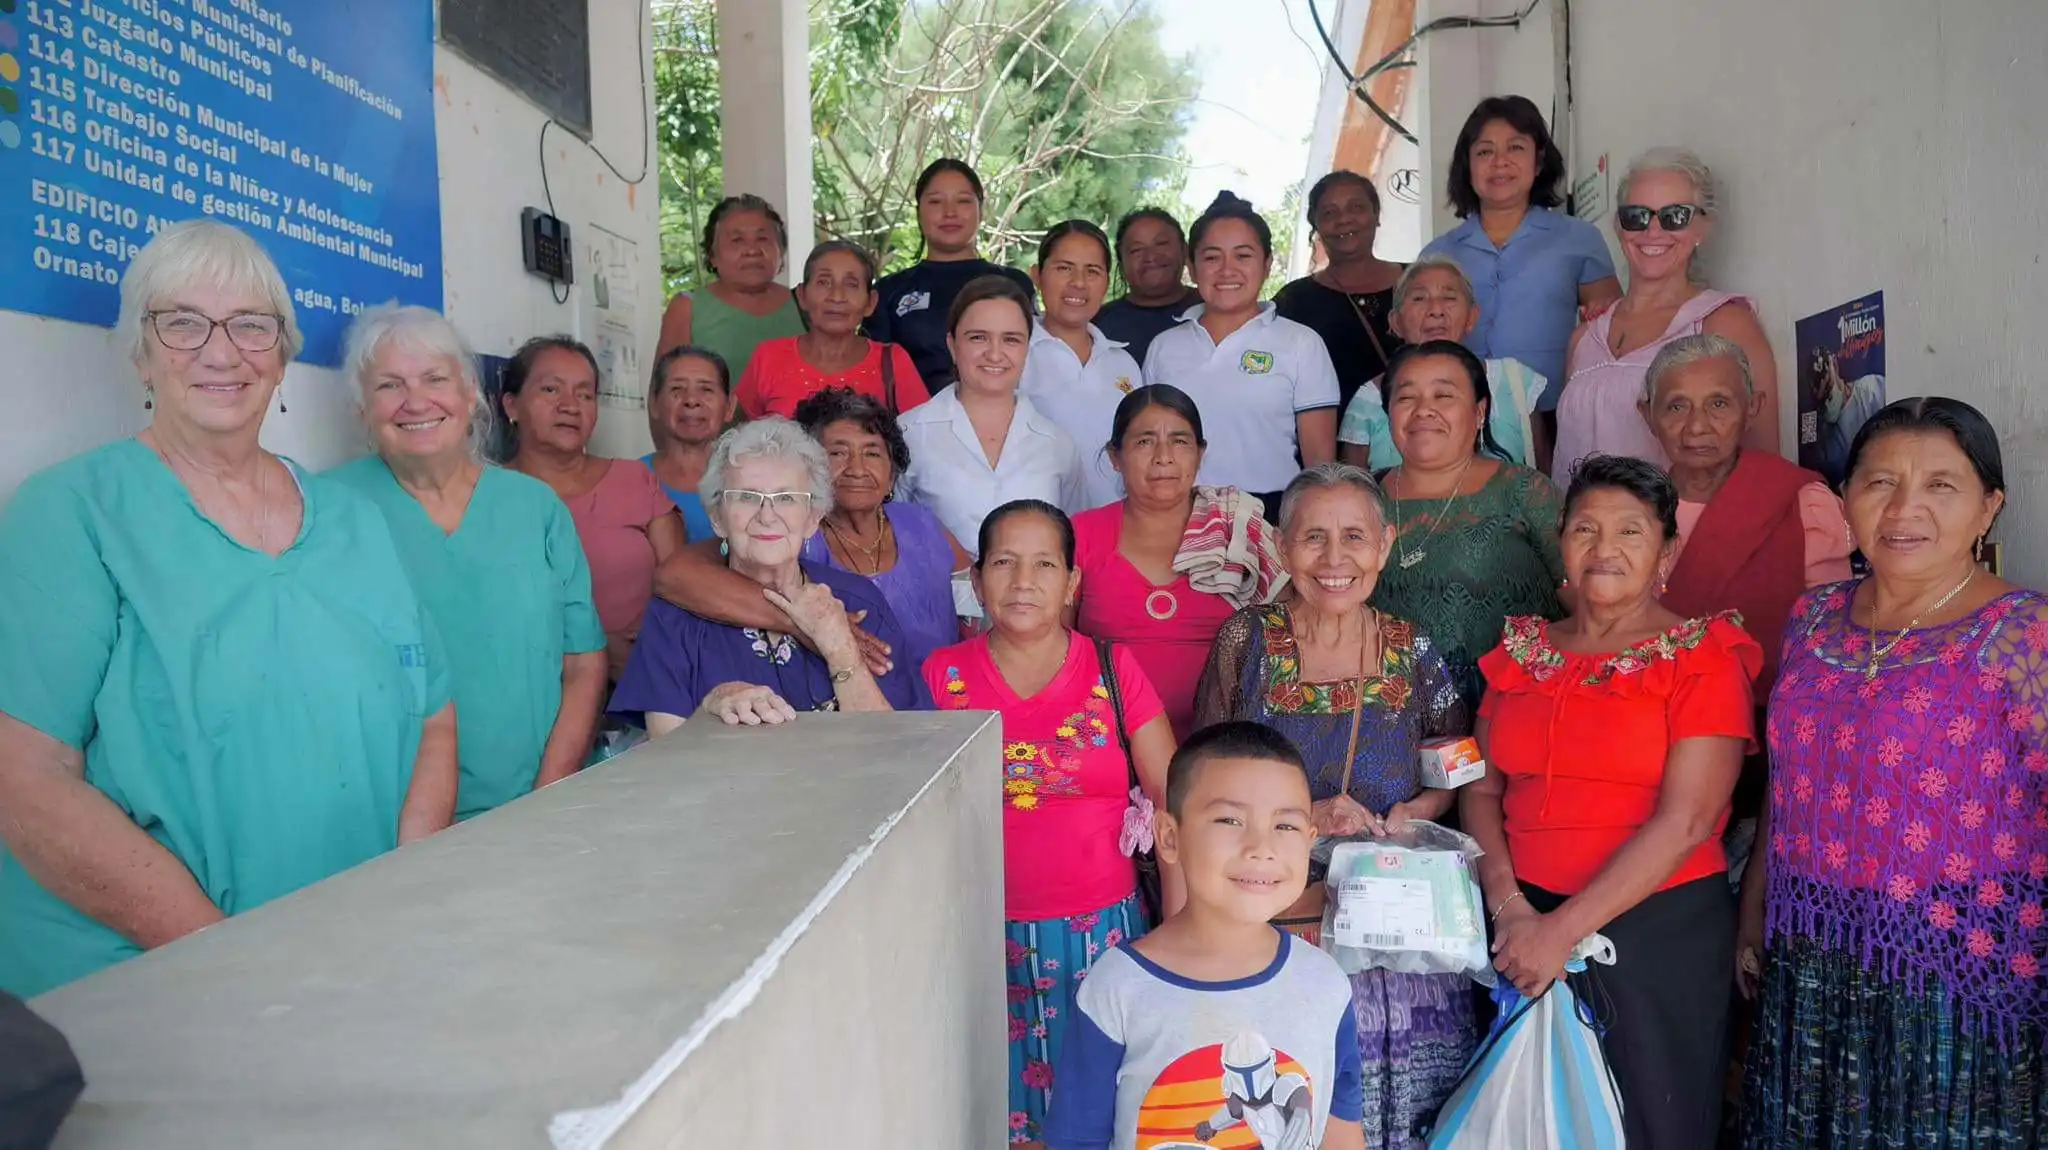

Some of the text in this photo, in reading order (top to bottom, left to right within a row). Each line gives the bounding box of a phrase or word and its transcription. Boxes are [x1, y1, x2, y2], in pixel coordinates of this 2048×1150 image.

[26, 1, 181, 86] 113 Catastro
[80, 0, 273, 102] Juzgado Municipal
[123, 0, 273, 76] icios Públicos
[193, 0, 402, 121] Municipal de Planificación
[28, 33, 374, 195] 114 Dirección Municipal de la Mujer
[30, 66, 237, 164] 115 Trabajo Social
[31, 99, 394, 248] 116 Oficina de la Niñez y Adolescencia
[31, 131, 423, 279] 117 Unidad de gestión Ambiental Municipal
[32, 178, 138, 229] EDIFICIO
[33, 214, 81, 245] 118
[294, 287, 338, 315] agua,
[33, 245, 119, 286] Ornato
